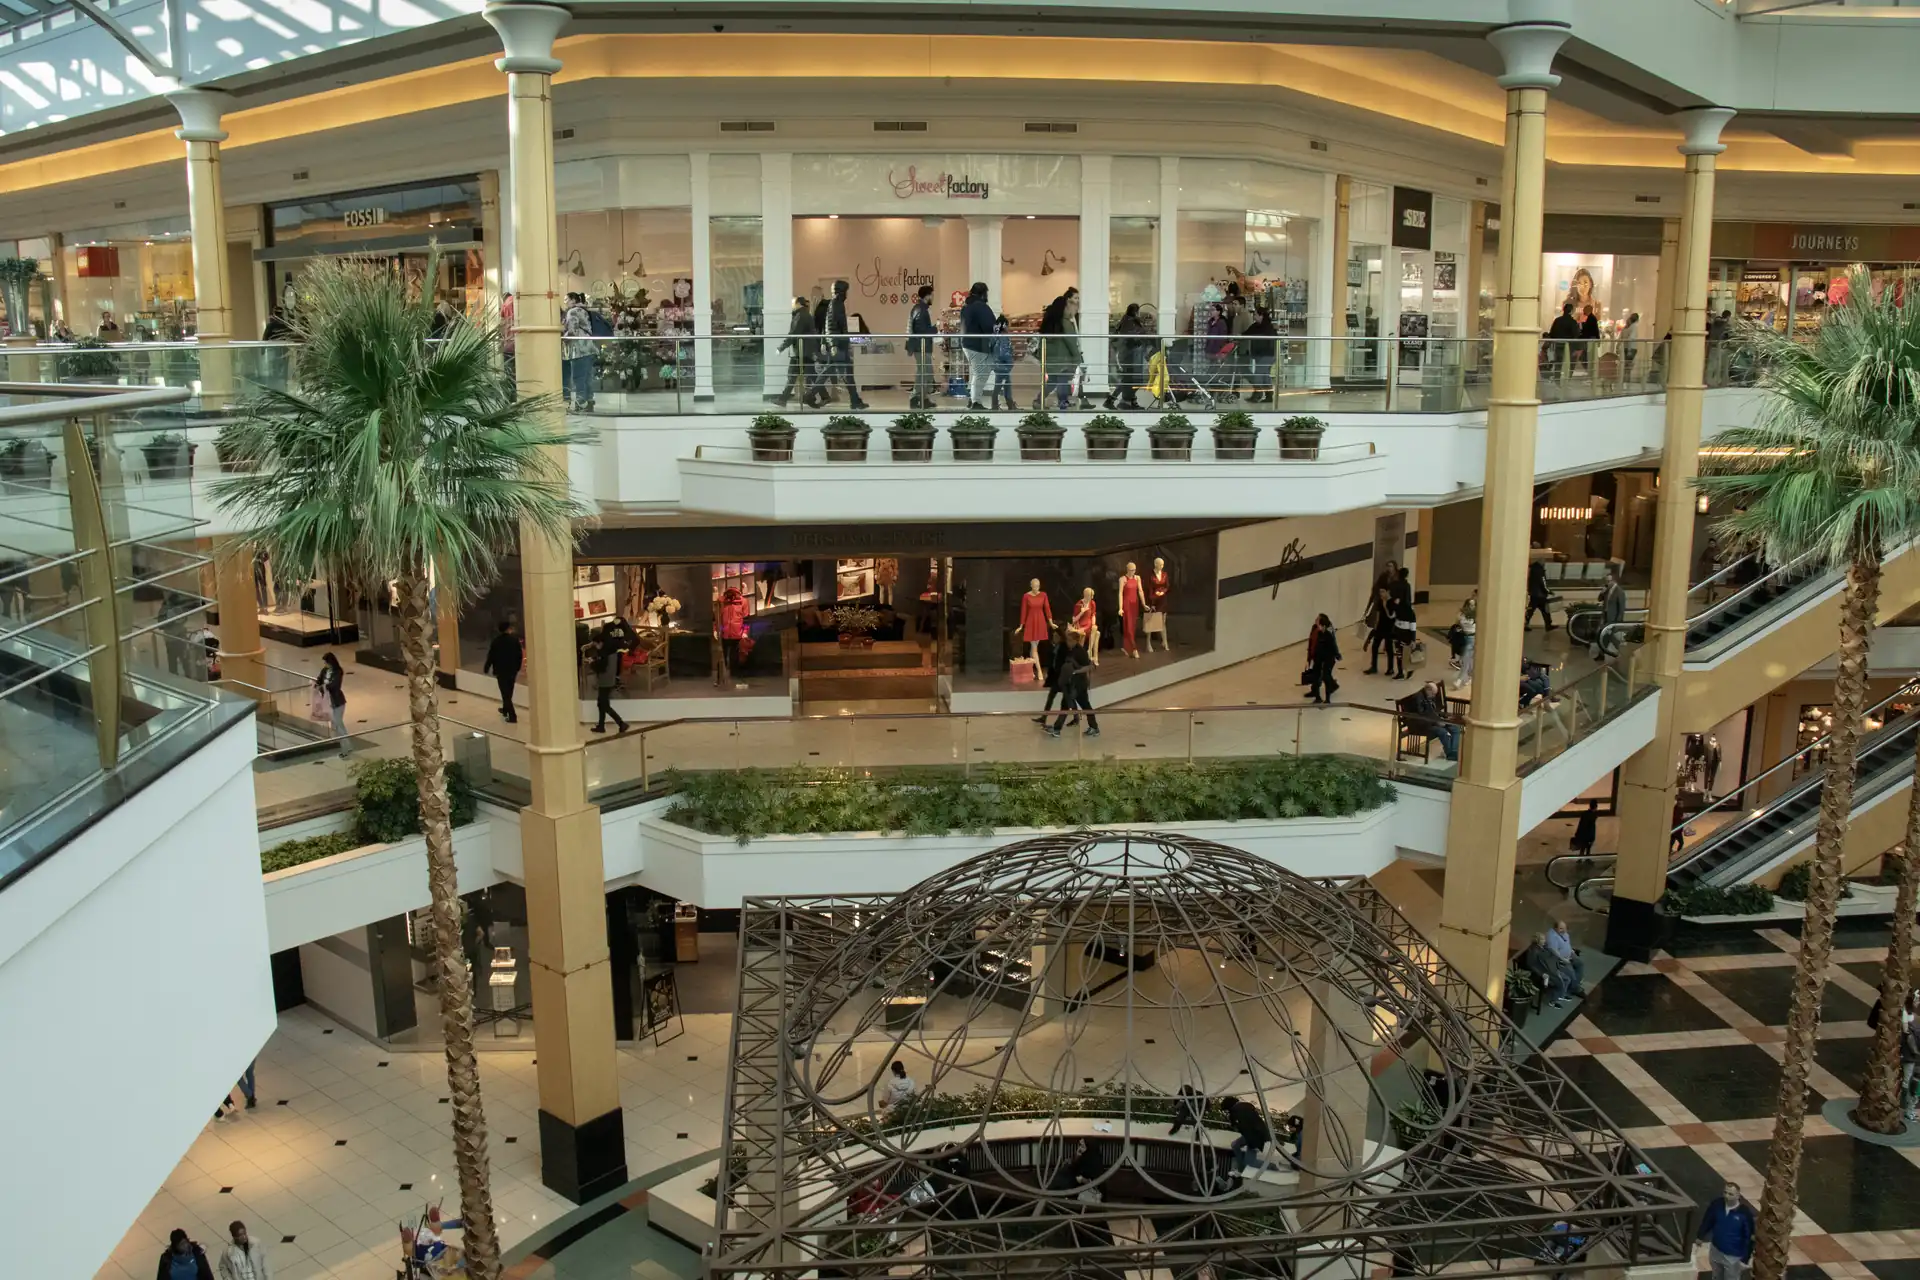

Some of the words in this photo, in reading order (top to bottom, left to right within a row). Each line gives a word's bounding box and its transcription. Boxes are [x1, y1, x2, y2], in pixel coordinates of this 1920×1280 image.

[889, 165, 945, 199] Sweet
[946, 174, 989, 199] factory
[1403, 208, 1426, 228] SEE
[1791, 235, 1859, 250] JOURNEYS
[855, 256, 902, 297] Sweet
[903, 268, 934, 291] factory
